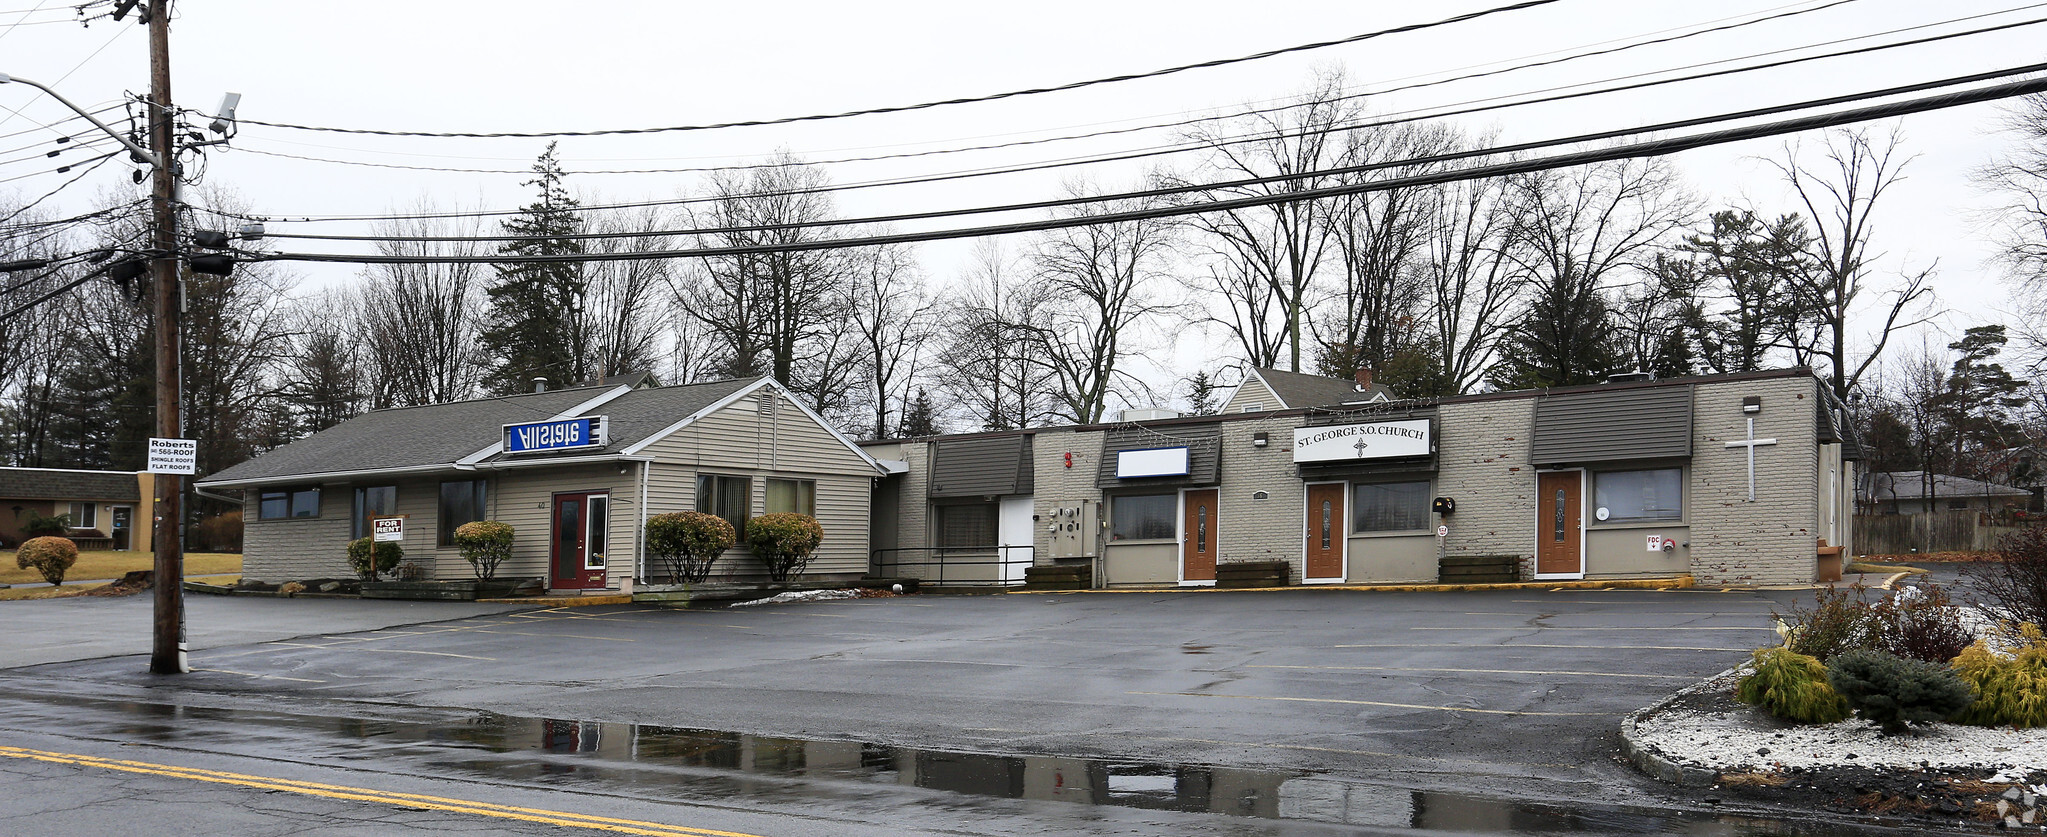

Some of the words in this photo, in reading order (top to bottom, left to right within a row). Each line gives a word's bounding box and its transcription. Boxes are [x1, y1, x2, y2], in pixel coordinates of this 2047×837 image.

[151, 440, 194, 448] Roberts
[1298, 437, 1312, 448] ST.
[1313, 427, 1357, 443] GEORGE
[1359, 425, 1376, 435] S.O.
[1378, 426, 1424, 440] CHURCH
